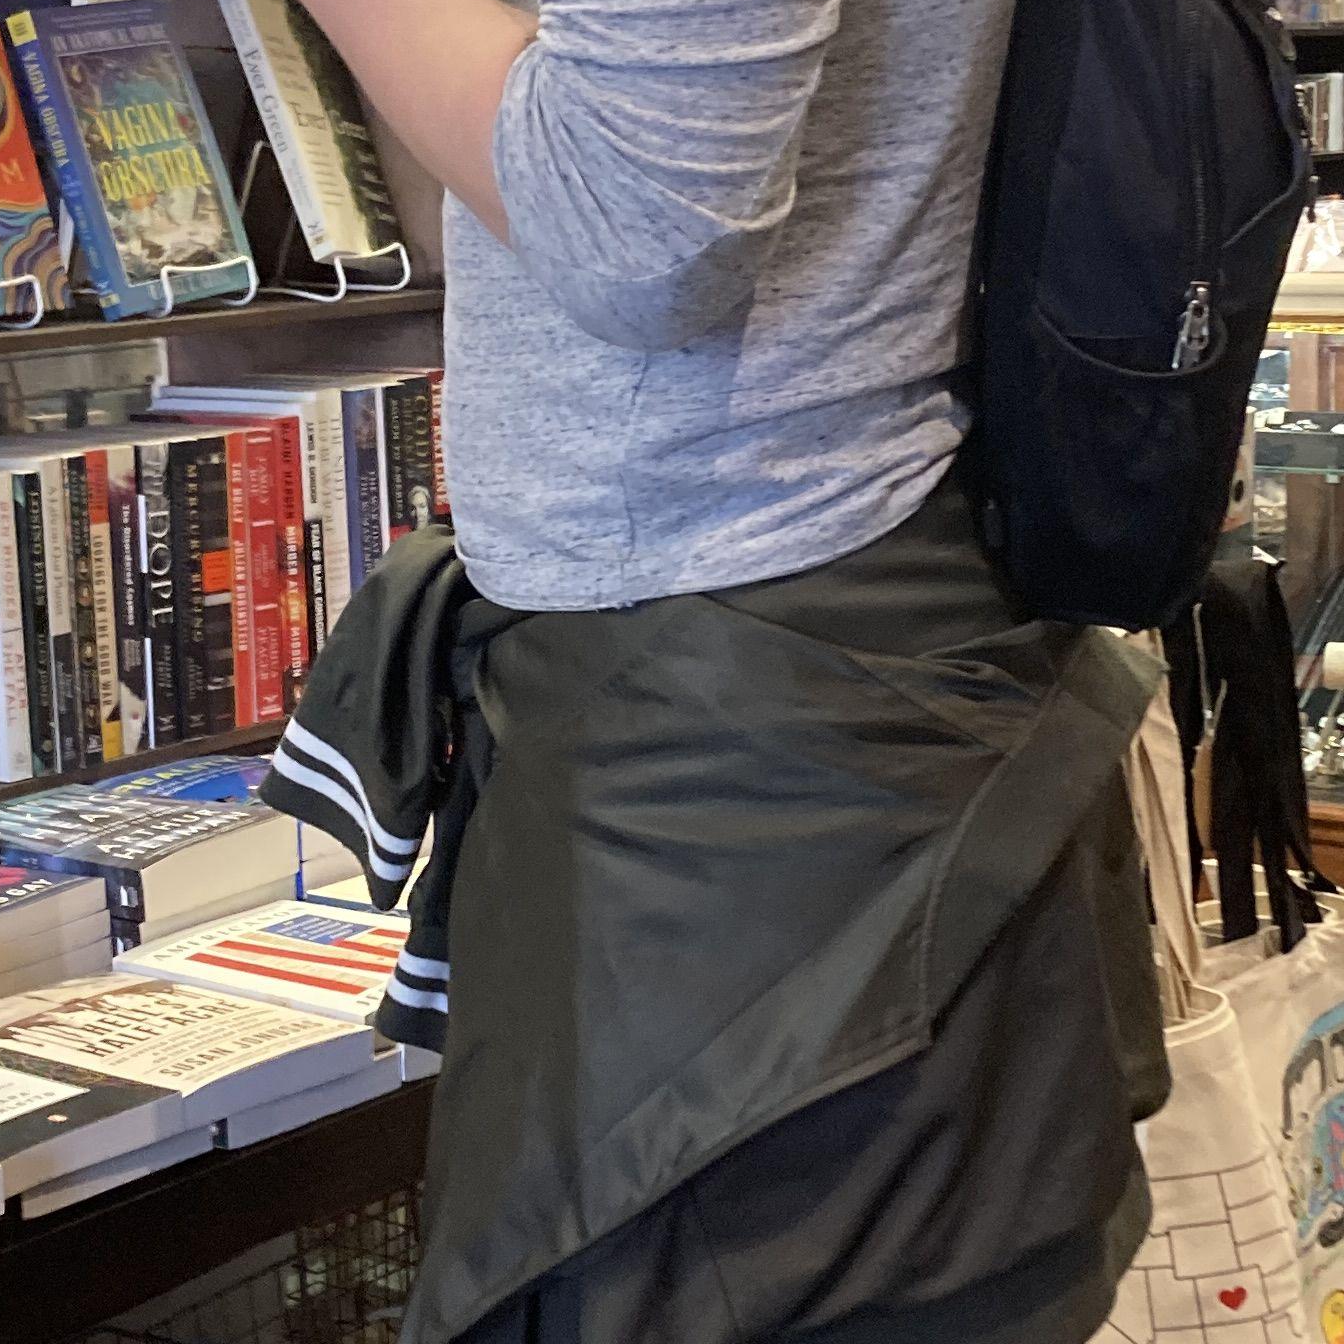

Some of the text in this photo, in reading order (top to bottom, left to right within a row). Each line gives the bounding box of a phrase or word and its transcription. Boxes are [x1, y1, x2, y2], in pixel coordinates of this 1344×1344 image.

[22, 50, 49, 104] VAGINA
[94, 101, 186, 151] VAGINA
[263, 95, 289, 154] Green
[99, 147, 212, 202] OBSCURA
[231, 462, 243, 484] THE
[283, 470, 296, 519] HARDEN
[121, 504, 132, 523] The
[186, 464, 201, 561] MERCURY
[0, 501, 17, 619] BEN RHODES
[93, 535, 108, 586] LOOKING
[122, 527, 134, 585] Disordered
[148, 509, 175, 628] DOPE
[286, 526, 298, 575] MURDER
[310, 523, 322, 594] FEAR OF BLACK
[32, 561, 47, 605] EDEN
[124, 588, 136, 626] Cosmos
[97, 619, 111, 640] THE
[290, 627, 302, 677] MISSION
[15, 653, 28, 710] AFTER
[98, 645, 113, 675] GOOD
[5, 681, 18, 726] FALL
[101, 681, 114, 706] WAR
[20, 797, 152, 840] HEART
[96, 807, 220, 854] ARTHUR
[112, 809, 251, 861] HERMAN
[5, 878, 54, 899] GAY
[159, 1046, 230, 1078] SUSAN
